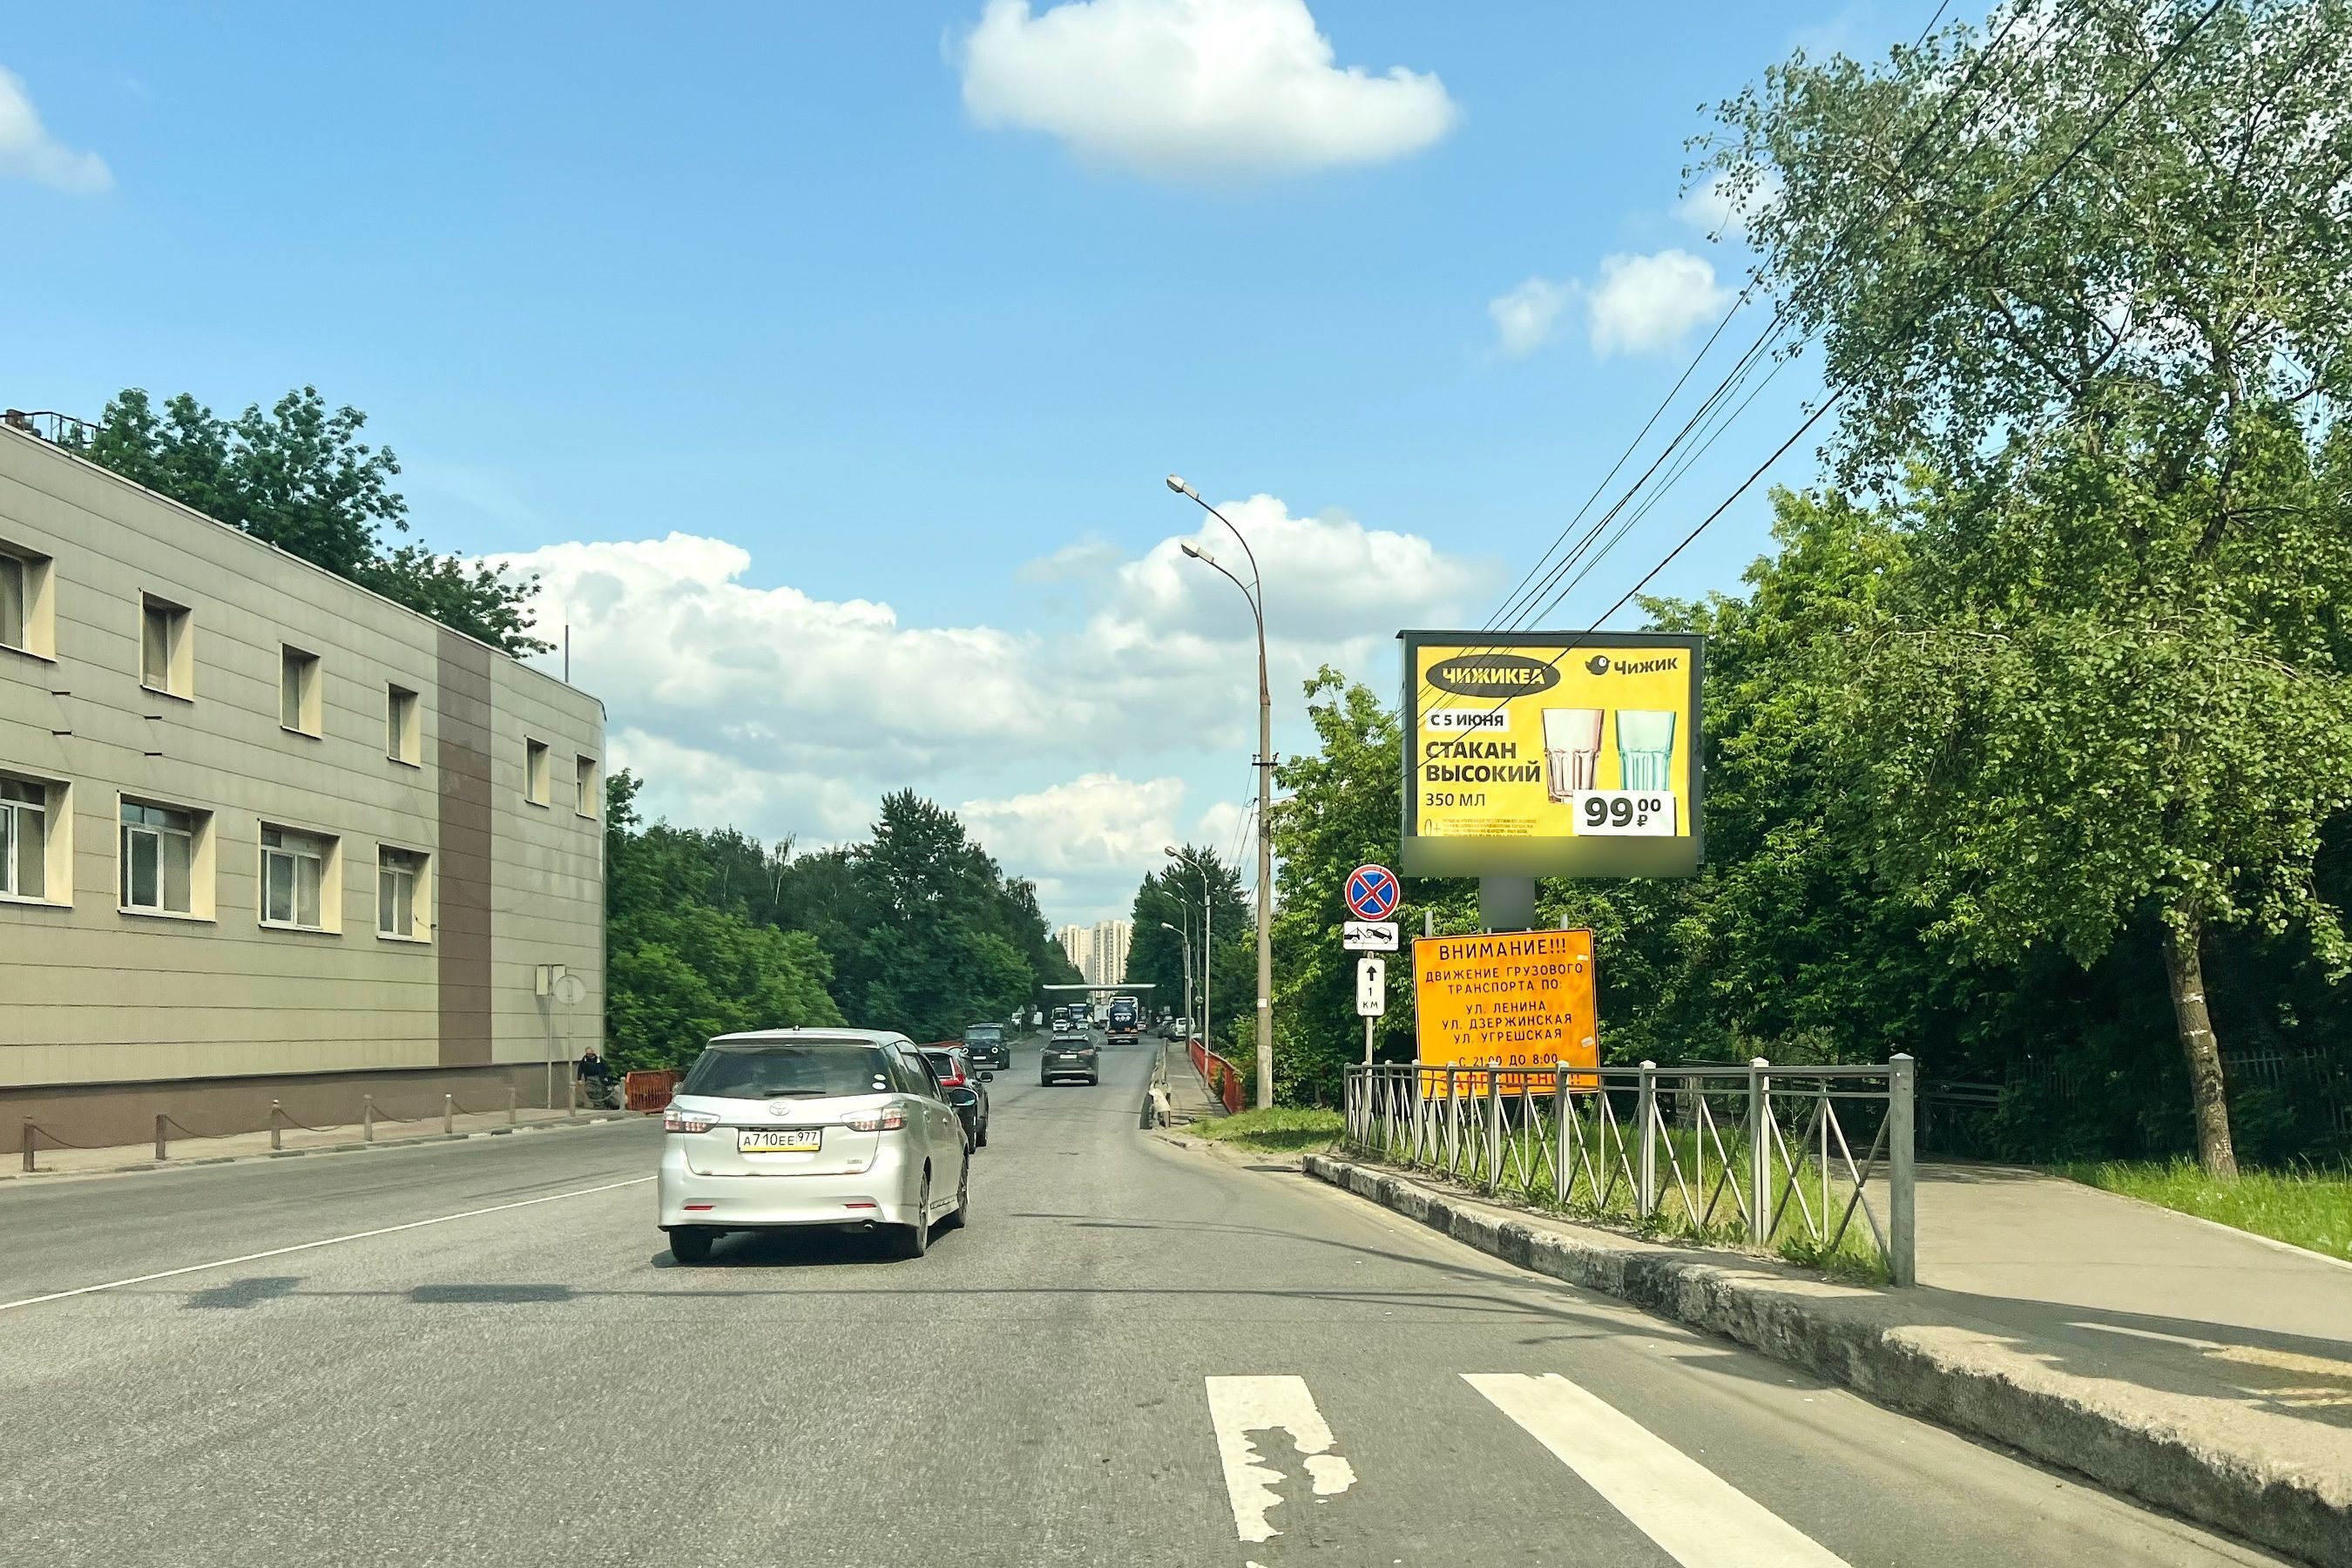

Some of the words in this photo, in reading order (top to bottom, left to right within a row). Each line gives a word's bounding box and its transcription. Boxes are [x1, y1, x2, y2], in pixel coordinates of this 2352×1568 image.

[1442, 666, 1546, 685] ЧИЖИКЕА
[1430, 713, 1440, 726] С
[1443, 714, 1452, 726] 5
[1456, 713, 1504, 727] ИЮНЯ
[1425, 740, 1517, 759] СТАКАН
[1426, 760, 1541, 782] ВЫСОКИЙ
[1425, 793, 1455, 806] 350
[1459, 794, 1485, 806] МЛ
[1585, 796, 1633, 827] 99
[1439, 938, 1566, 961] ВНИМАНИЕ!!!
[1425, 967, 1499, 983] ДВИЖЕНИЕ
[1506, 963, 1583, 977] ГРУЗОВОГО
[1368, 987, 1372, 997] 1
[1448, 981, 1534, 995] ТРАНСПОРТА
[1466, 1004, 1486, 1015] УЛ.
[1493, 1000, 1546, 1013] ЛЕНИНА
[1442, 1019, 1463, 1031] УЛ.
[1470, 1013, 1571, 1029] ДЗЕРЖИНСКАЯ
[1454, 1033, 1474, 1044] УЛ.
[1481, 1028, 1562, 1043] УГРЕШСКАЯ
[1509, 1054, 1526, 1067] ДО
[1532, 1053, 1558, 1064] 8:00
[743, 1132, 794, 1146] А710ЕЕ
[797, 1132, 817, 1142] 977
